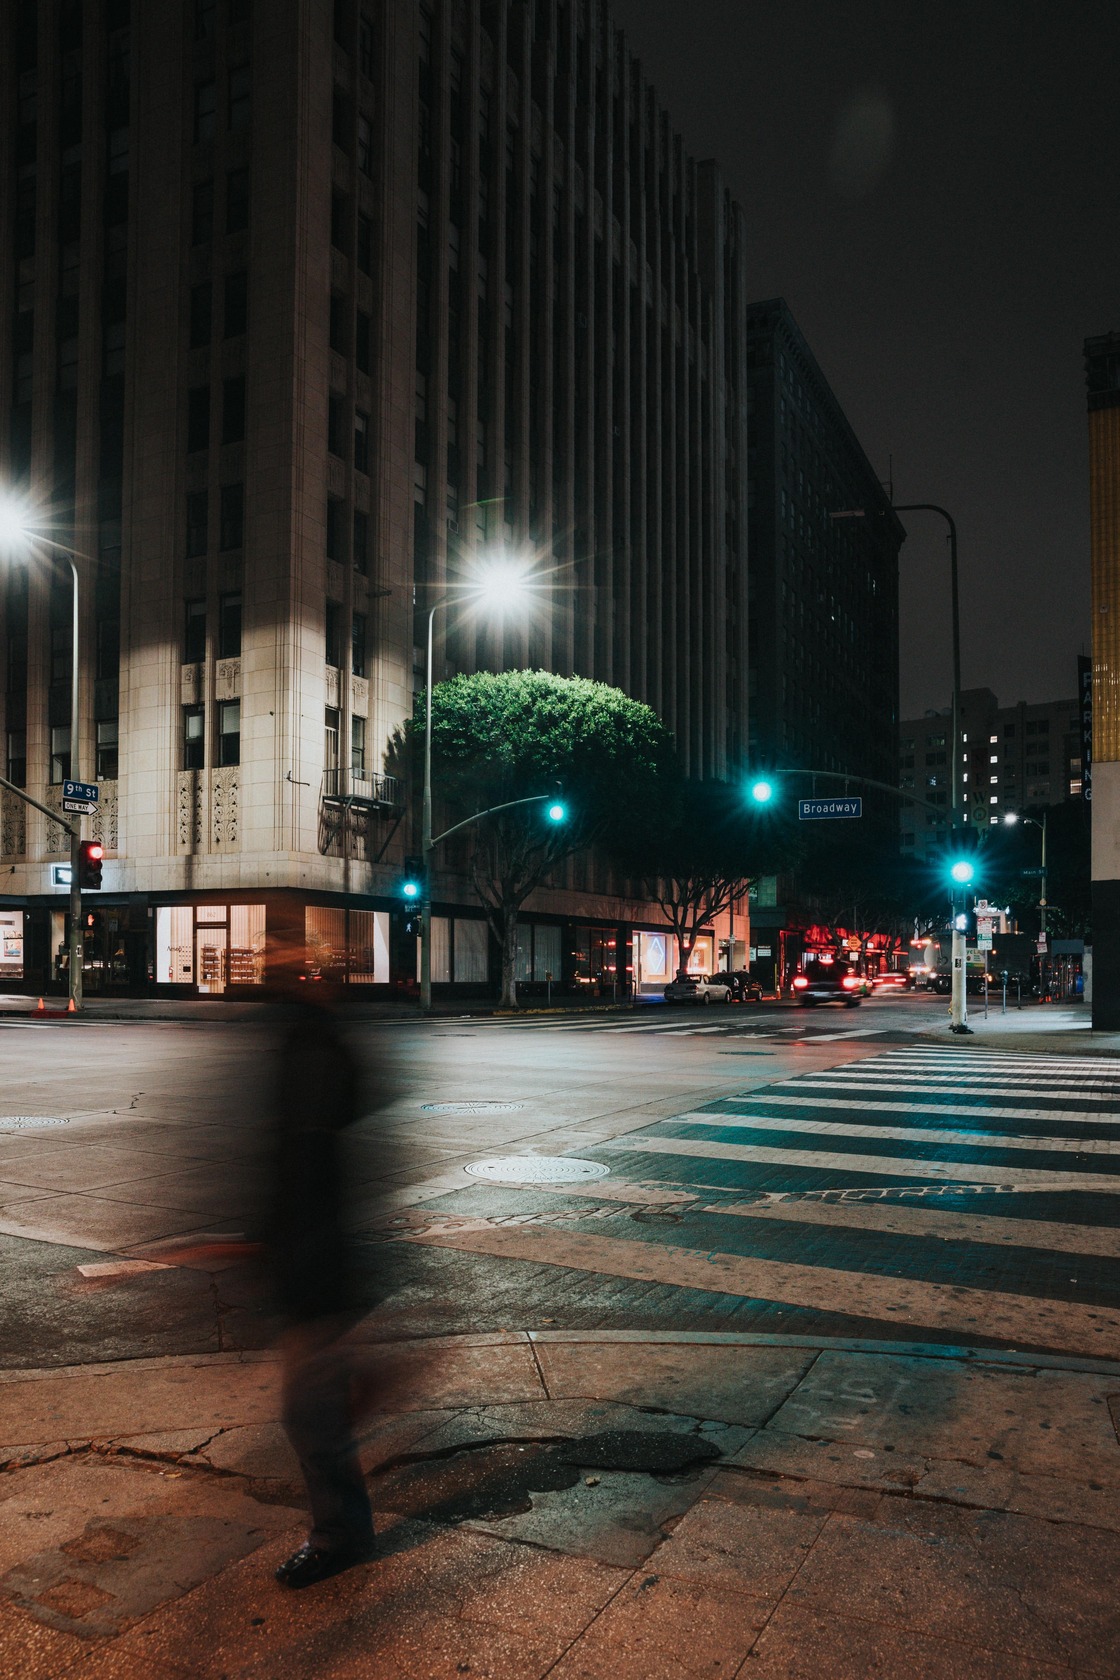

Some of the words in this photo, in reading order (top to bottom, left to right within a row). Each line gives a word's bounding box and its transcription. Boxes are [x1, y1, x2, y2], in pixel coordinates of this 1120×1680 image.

[1083, 671, 1092, 802] PARKING
[66, 783, 83, 795] 9th
[85, 788, 96, 798] St
[66, 802, 77, 810] ONE
[803, 803, 857, 814] Broadway
